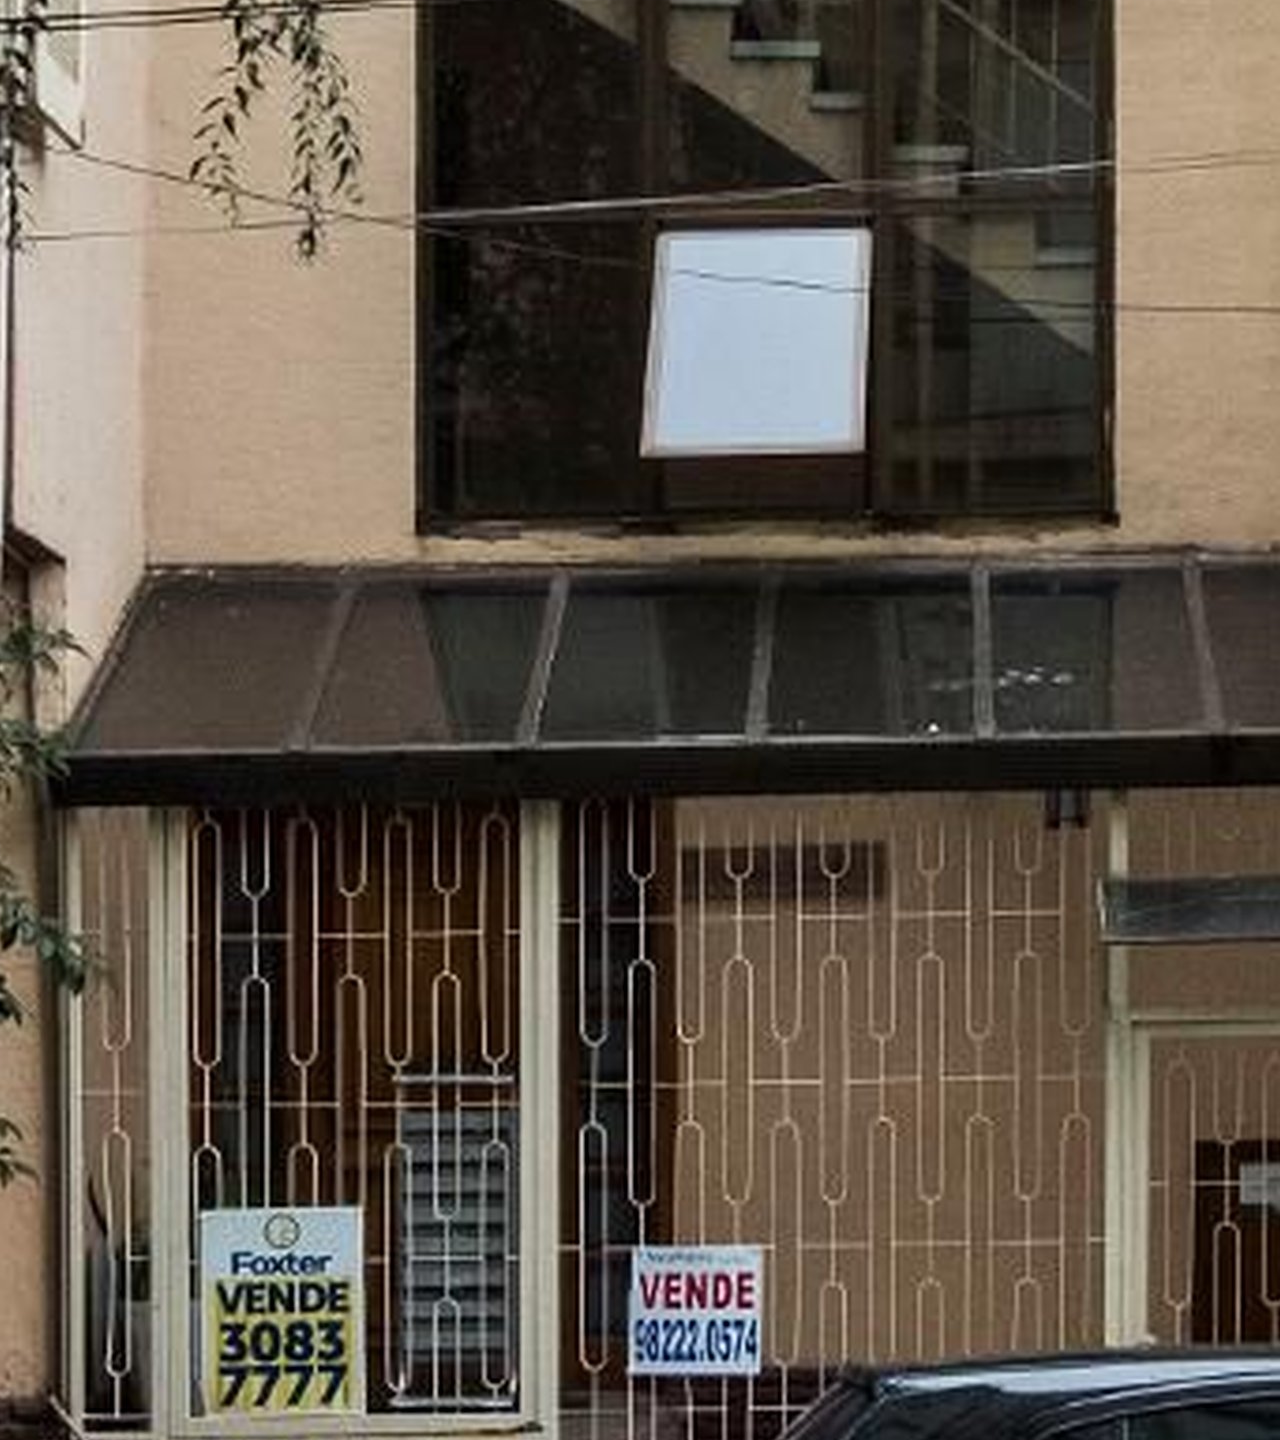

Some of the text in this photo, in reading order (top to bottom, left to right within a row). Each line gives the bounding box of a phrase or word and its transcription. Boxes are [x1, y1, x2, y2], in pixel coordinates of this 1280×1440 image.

[230, 1251, 334, 1275] Foxter
[216, 1281, 351, 1315] VENDE
[640, 1271, 755, 1310] VENDE
[219, 1321, 346, 1362] 3083
[635, 1318, 758, 1362] 98222.0574
[219, 1365, 348, 1407] 7777
